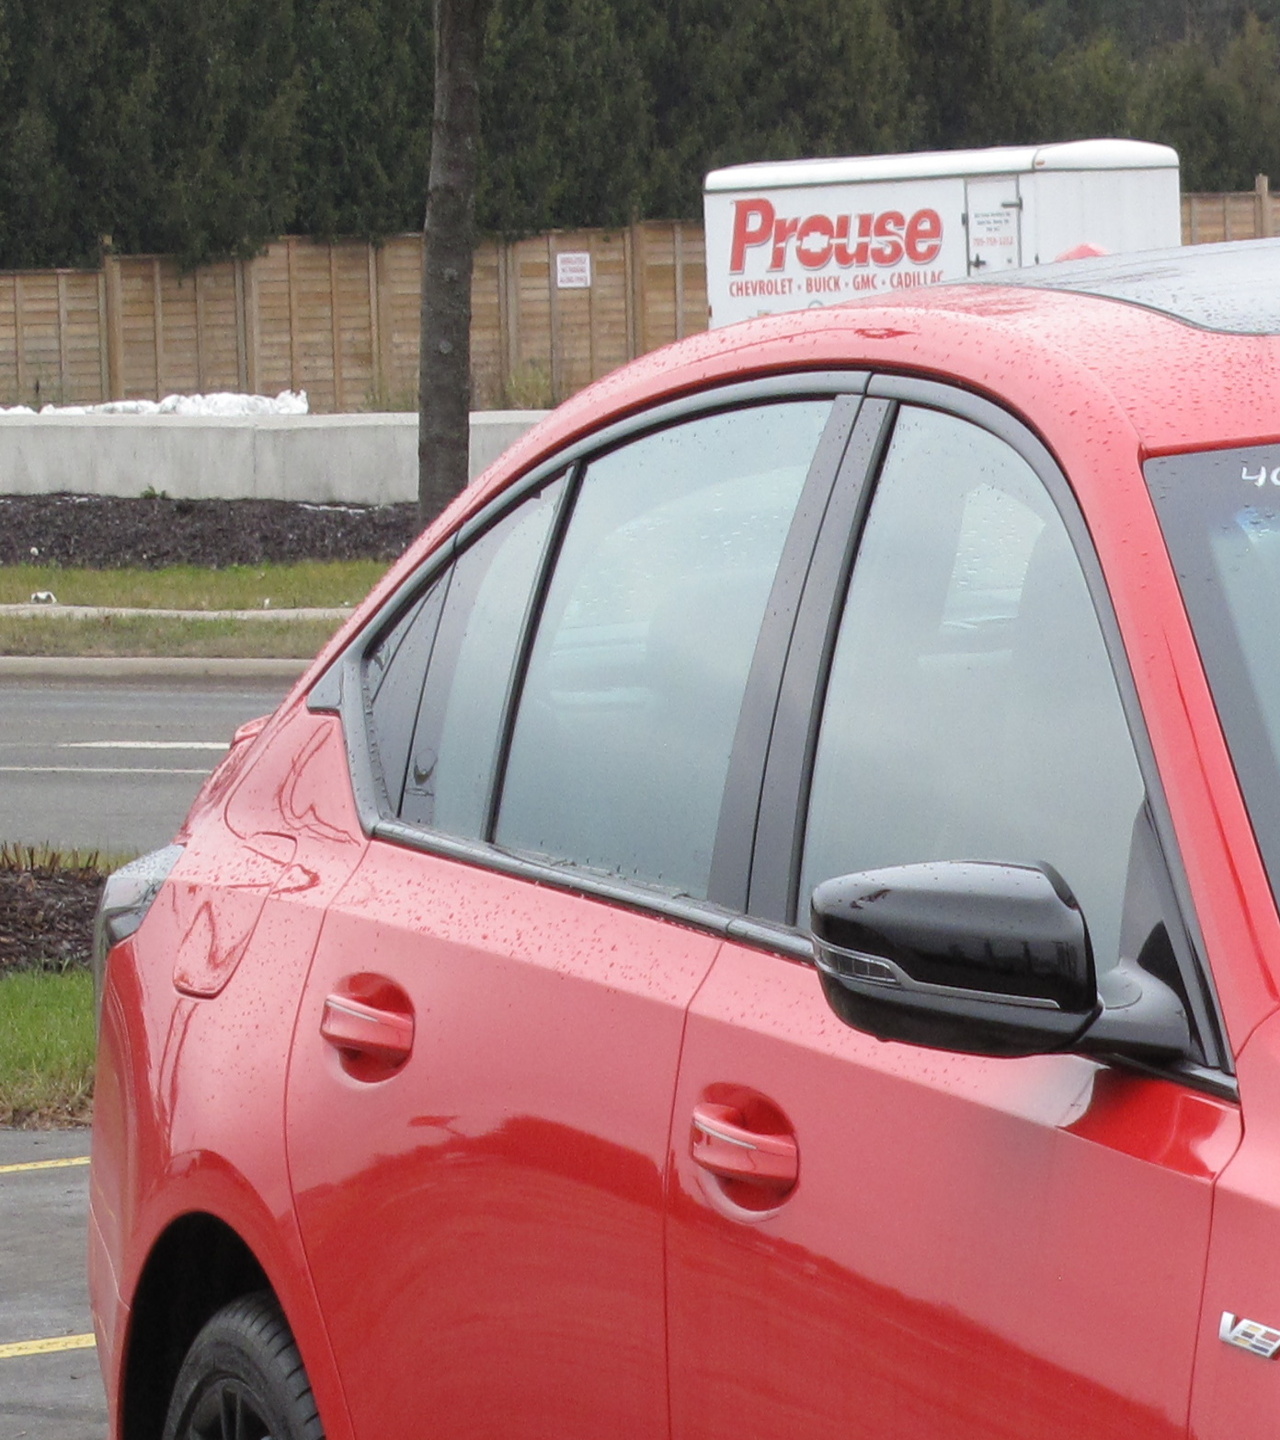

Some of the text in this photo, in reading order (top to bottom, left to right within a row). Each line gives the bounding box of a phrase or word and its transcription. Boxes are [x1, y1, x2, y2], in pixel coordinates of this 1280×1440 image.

[729, 198, 943, 275] Prouse
[729, 270, 944, 298] CHEVROLET BUICK GMC CADILLAC
